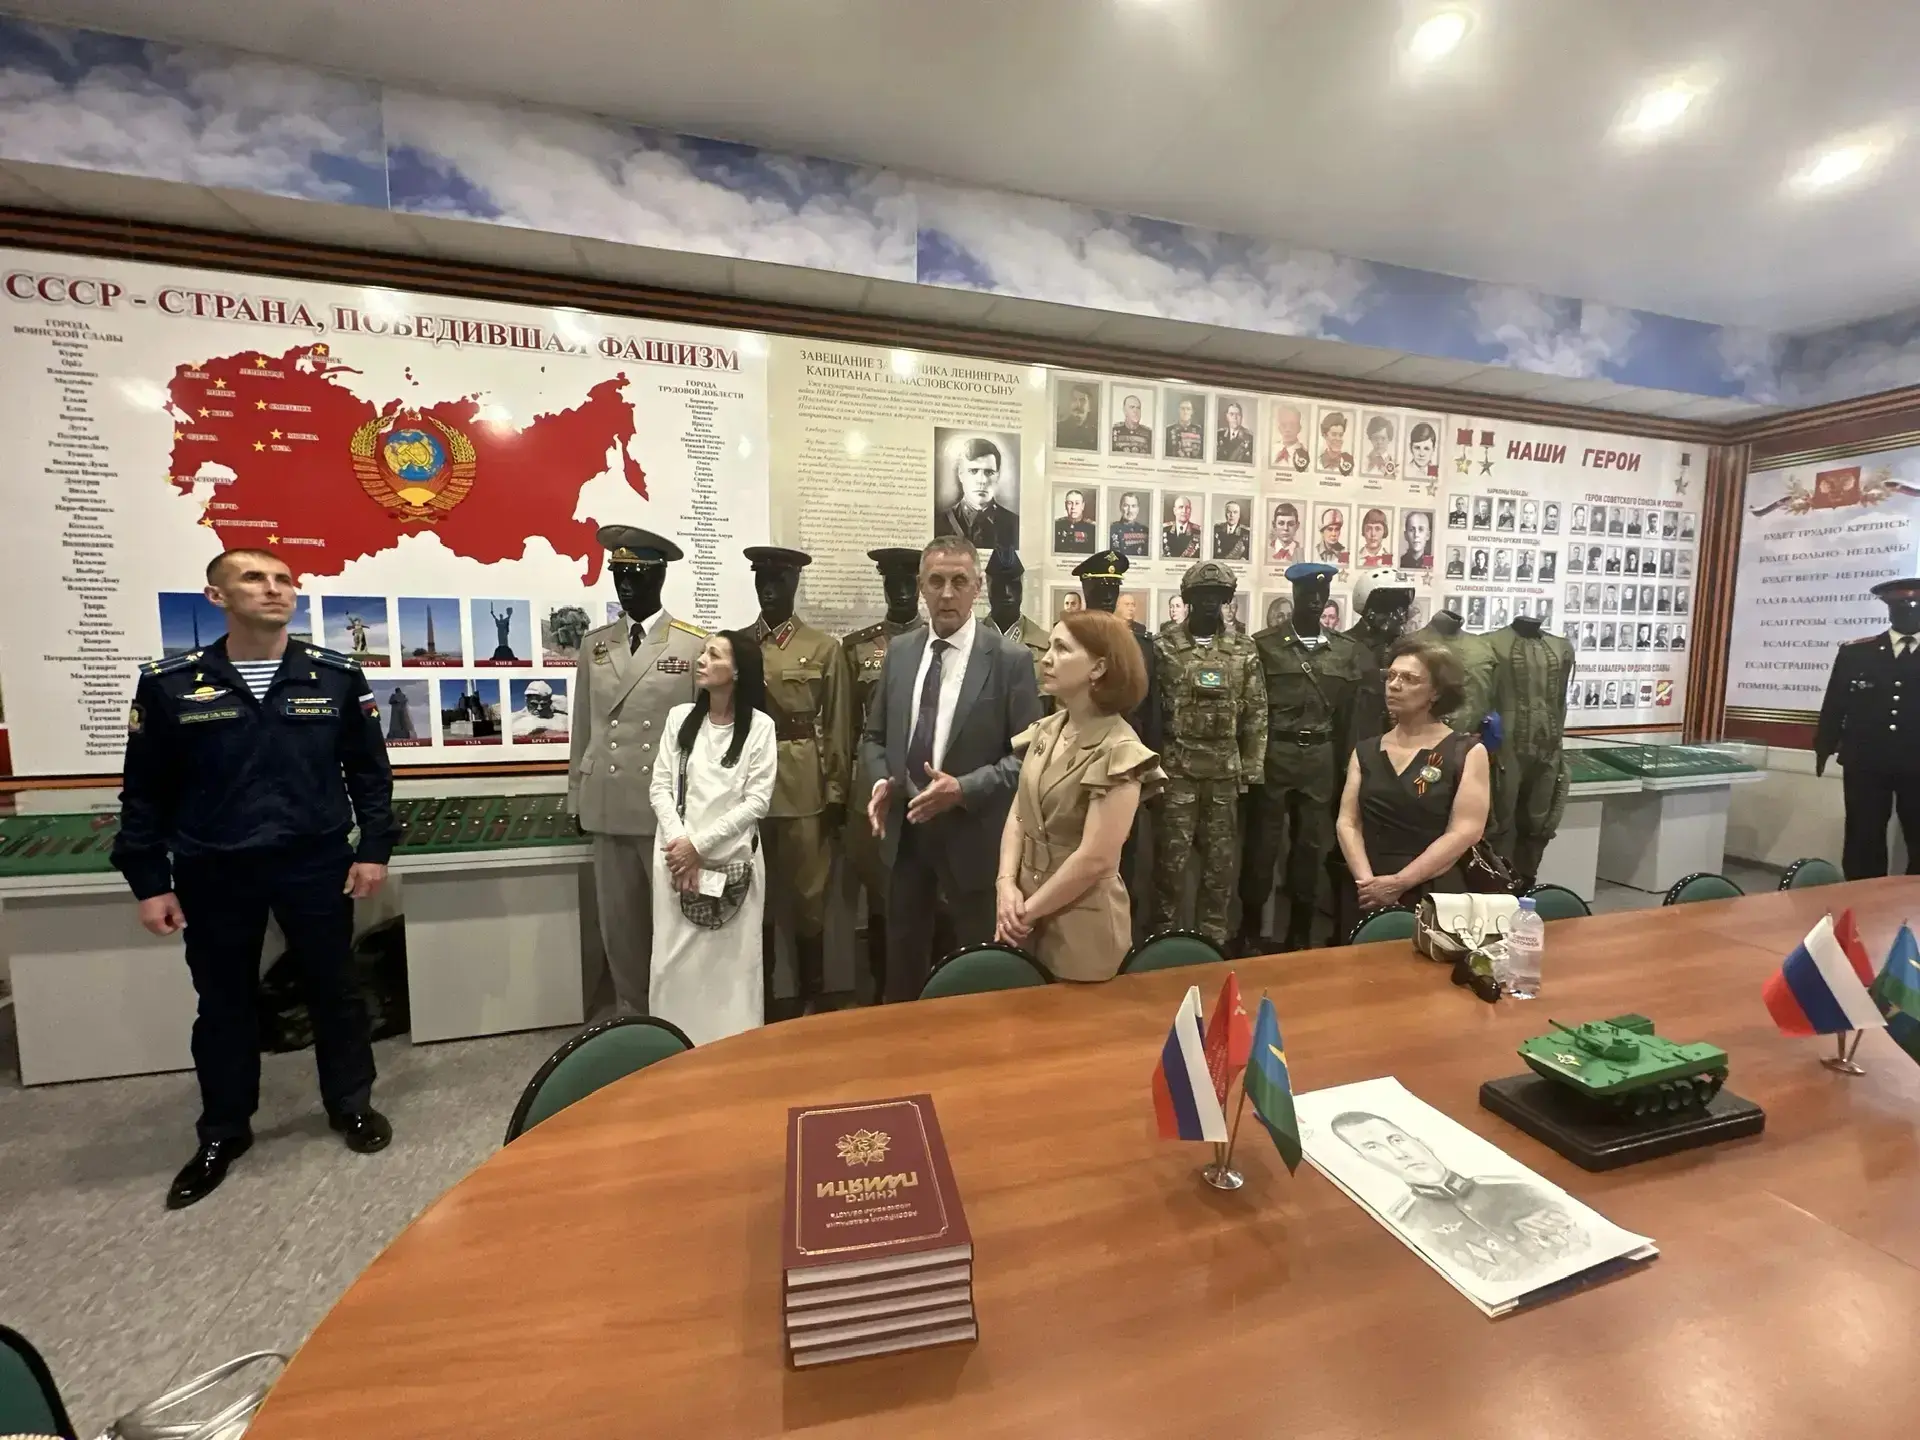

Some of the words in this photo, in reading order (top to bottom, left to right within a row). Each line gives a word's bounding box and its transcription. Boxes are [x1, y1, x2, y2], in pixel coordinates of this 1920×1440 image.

[5, 273, 122, 307] СССР
[158, 289, 325, 332] СТРАНА,
[597, 334, 741, 372] ФАШИЗМ
[45, 319, 90, 330] ГОРОДА
[14, 326, 79, 338] ВОИНСКОЙ
[82, 330, 123, 342] СЛАВЫ
[800, 350, 874, 369] ЗАВЕЩАНИЕ
[951, 368, 1020, 384] ЛЕНИНГРАДА
[686, 380, 717, 388] ГОРОДА
[806, 364, 870, 382] КАПИТАНА
[900, 375, 982, 393] МАСЛОВСКОГО
[984, 383, 1015, 396] СЫНУ
[658, 385, 700, 395] ТРУДОВОЙ
[702, 390, 744, 399] ДОБЛЕСТИ
[1506, 440, 1566, 464] НАШИ
[1582, 448, 1641, 472] ГЕРОИ
[1585, 493, 1602, 502] ГЕРОИ
[1603, 495, 1637, 505] СОВЕТСКОГО
[1798, 526, 1842, 538] ТРУДНО
[1847, 548, 1860, 556] НЕ
[1598, 664, 1626, 672] КАВАЛЕРЫ
[1774, 662, 1829, 671] СТРАШНО
[1782, 683, 1822, 692] ЖИЗНЬ
[816, 1172, 918, 1198] ПАМЯТИ
